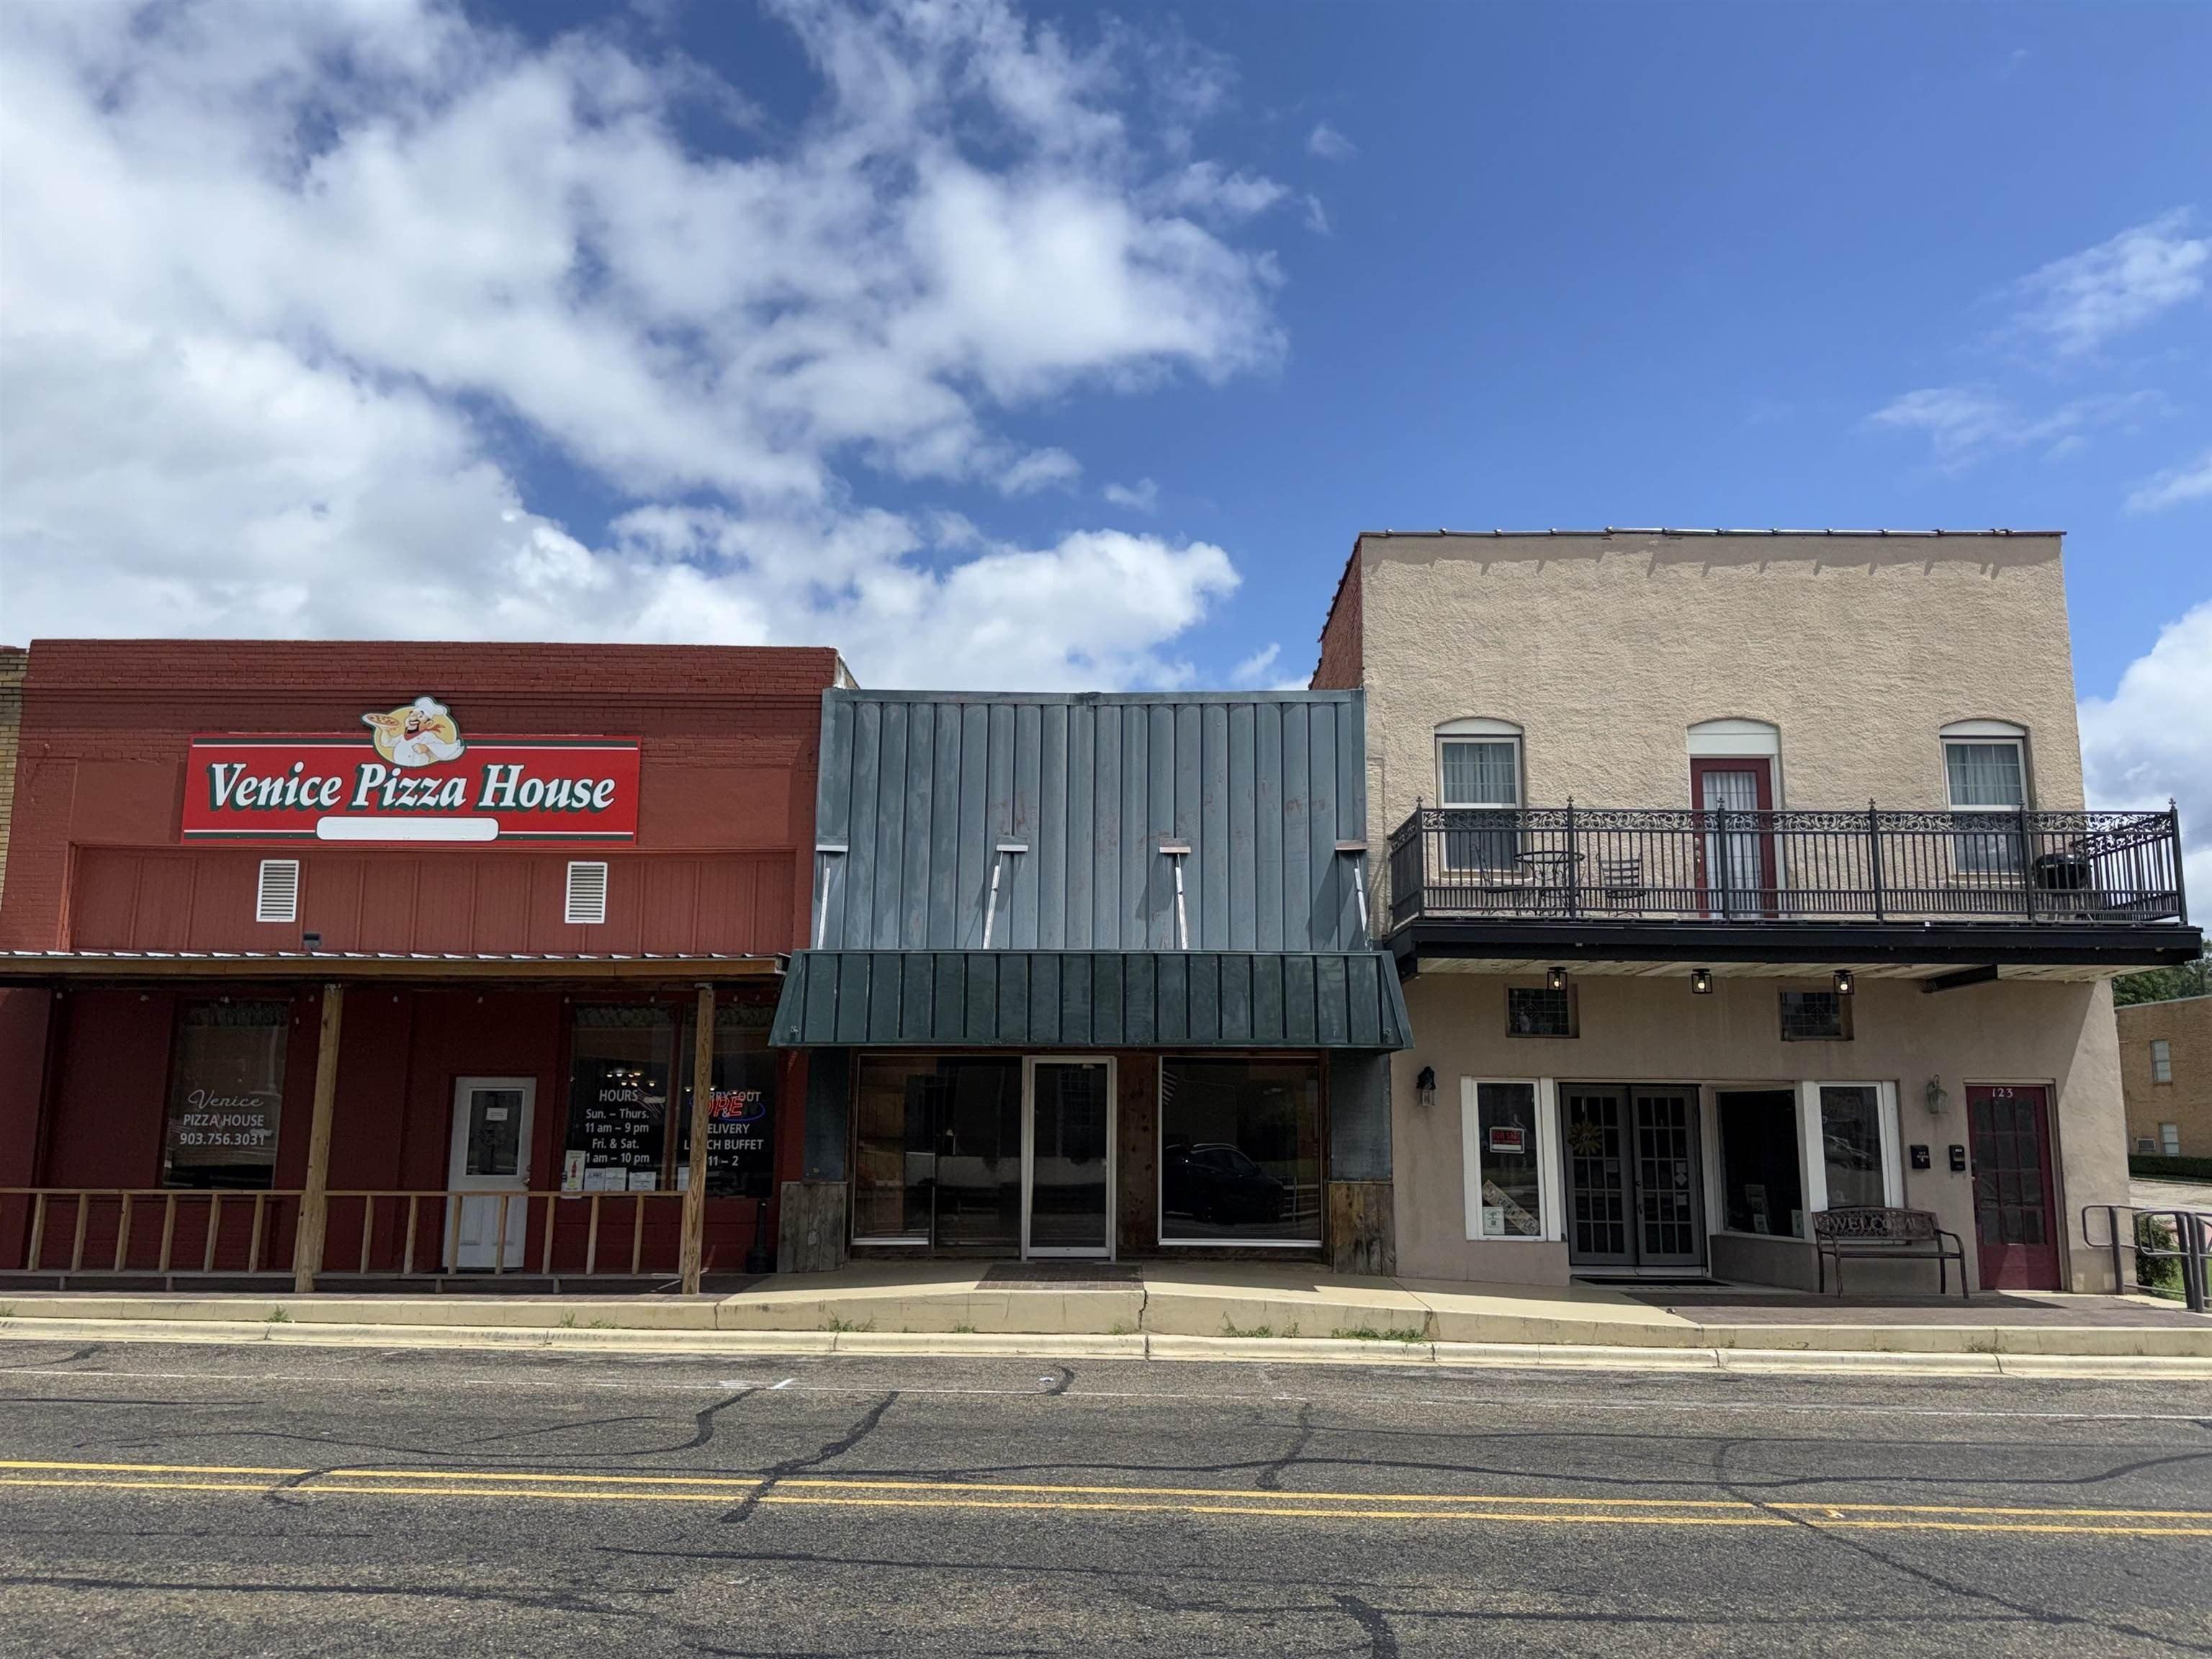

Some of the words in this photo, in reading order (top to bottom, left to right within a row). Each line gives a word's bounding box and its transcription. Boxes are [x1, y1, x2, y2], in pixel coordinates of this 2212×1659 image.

[210, 761, 343, 809] Venice
[350, 763, 467, 809] Pizza
[476, 763, 616, 809] House
[188, 1089, 264, 1110] Venice
[599, 1089, 638, 1102] HOURS
[1992, 1088, 2013, 1098] 123
[586, 1109, 606, 1119] Sun.
[620, 1108, 649, 1119] Thurs.
[184, 1114, 219, 1127] PIZZA
[222, 1115, 264, 1127] HOUSE
[585, 1123, 595, 1133] 11
[597, 1124, 612, 1133] am
[625, 1123, 631, 1133] 9
[634, 1124, 649, 1136] pm
[708, 1123, 750, 1134] ELIVERY
[180, 1133, 265, 1146] 903.756.3031
[593, 1138, 606, 1149] Fri.
[610, 1138, 617, 1149] &
[621, 1138, 639, 1149] Sat.
[684, 1139, 721, 1150] LCH
[724, 1139, 764, 1150] BUFFET
[593, 1154, 608, 1163] am
[621, 1153, 631, 1163] 10
[634, 1154, 649, 1166] pm
[708, 1156, 719, 1166] 11
[732, 1155, 739, 1166] 2
[1829, 1216, 1924, 1231] WELCOM
